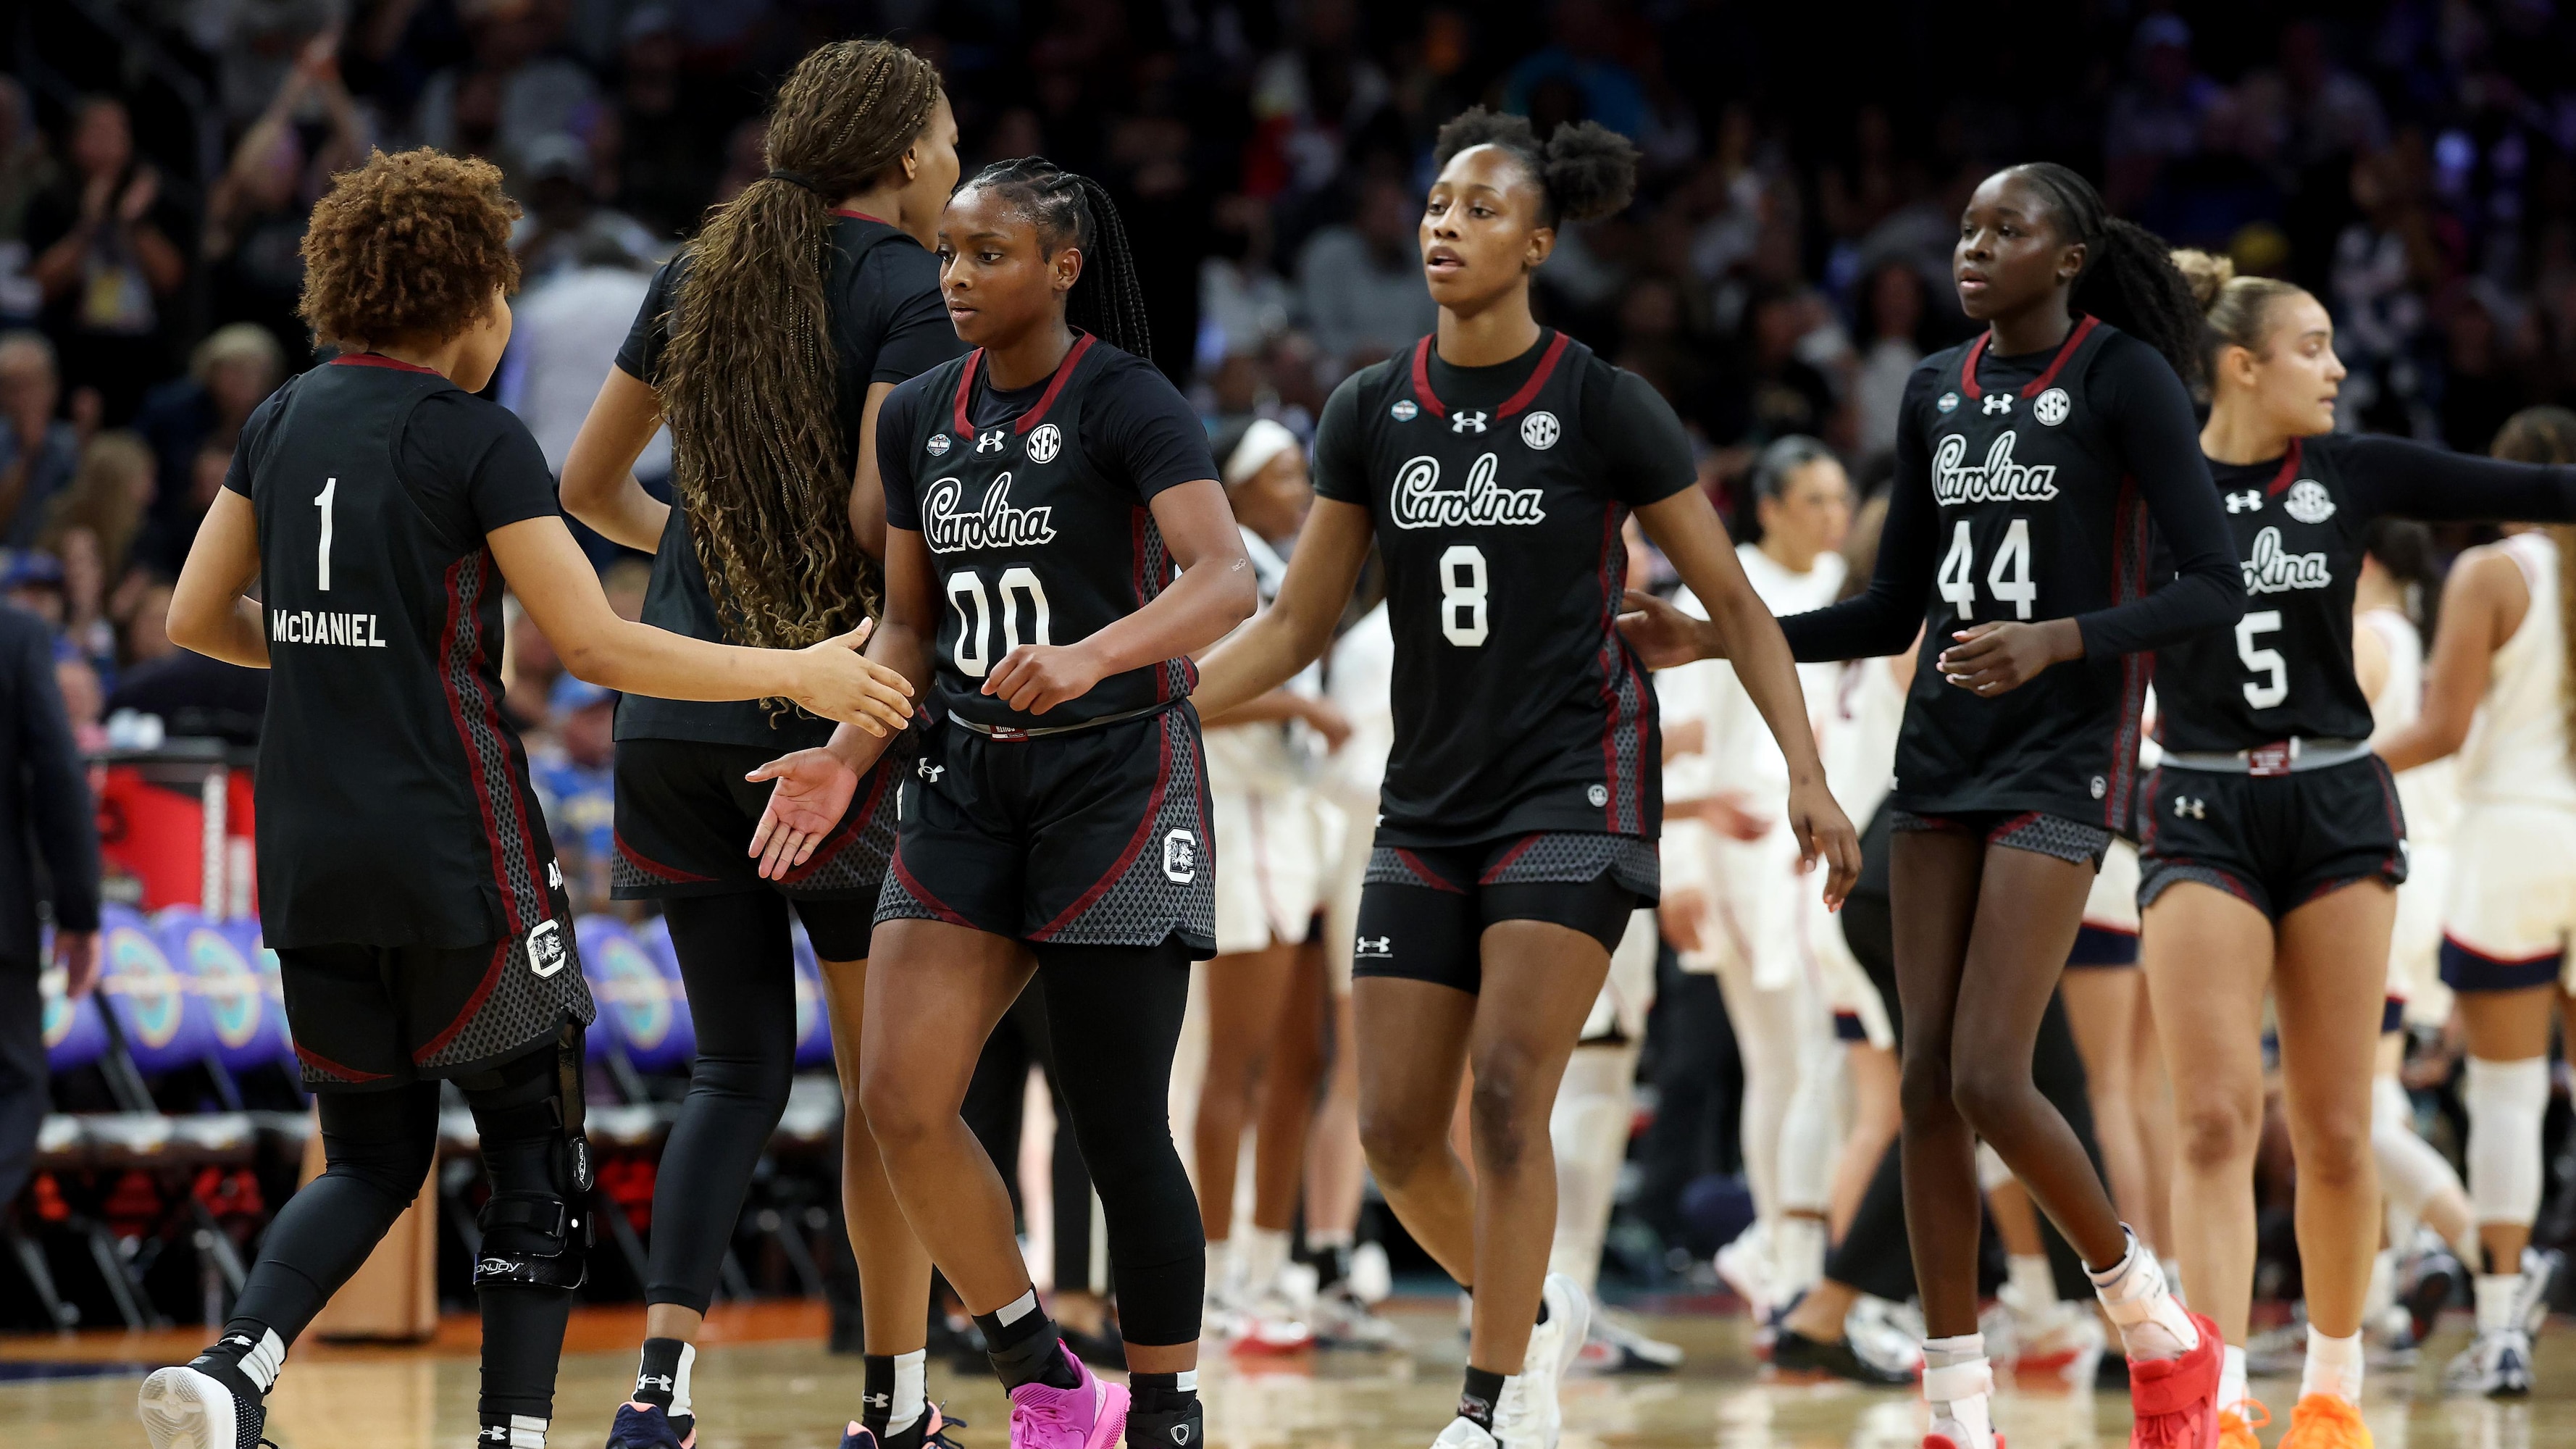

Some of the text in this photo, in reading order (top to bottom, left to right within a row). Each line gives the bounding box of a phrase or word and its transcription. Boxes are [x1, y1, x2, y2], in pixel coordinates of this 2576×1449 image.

[1029, 425, 1059, 461] SEC
[1525, 414, 1557, 446] SEC
[2036, 391, 2067, 422] SEC
[1390, 452, 1547, 530] Carolina
[1931, 430, 2059, 507] Carolina
[314, 477, 336, 591] 1
[922, 472, 1057, 554] Carolina
[1439, 545, 1489, 647] 8
[1937, 519, 2036, 620] 44
[2240, 526, 2333, 596] olina
[272, 609, 388, 647] McDANIEL
[947, 567, 1050, 677] 00
[2235, 609, 2288, 710] 5
